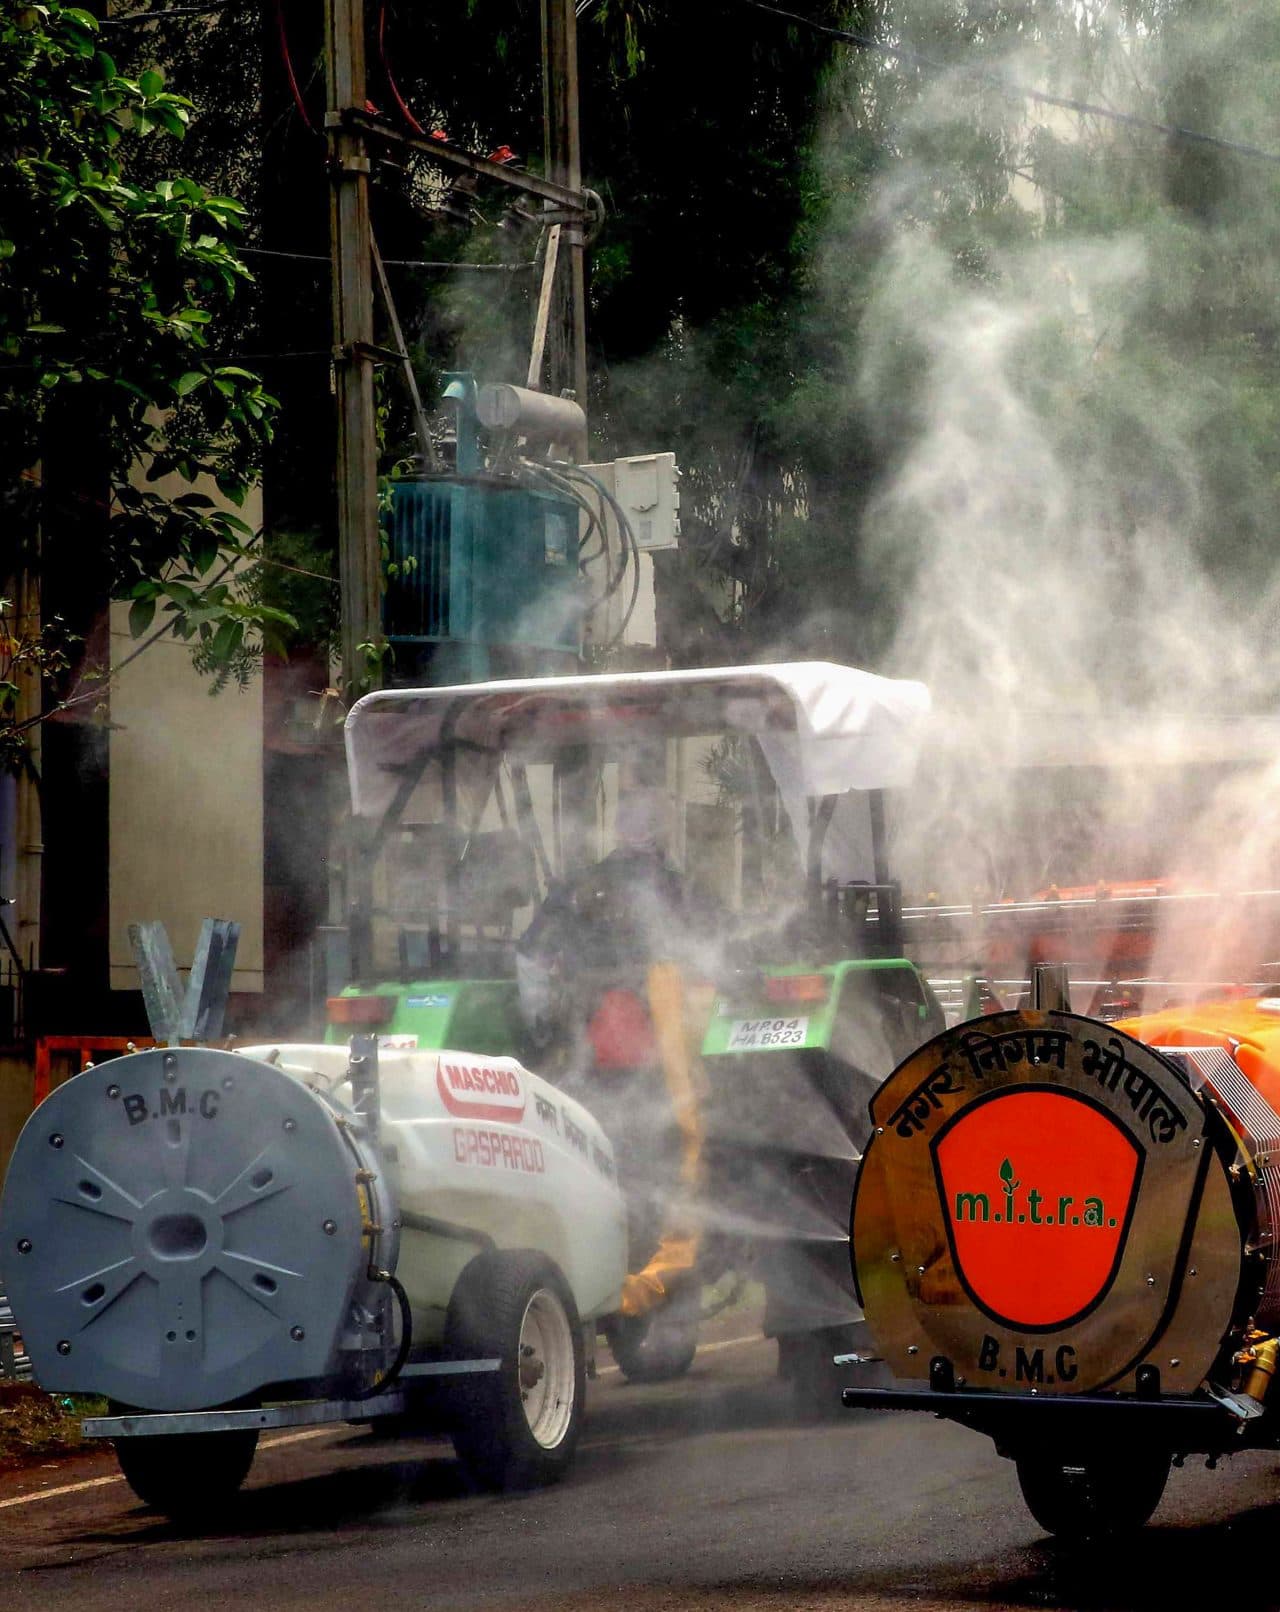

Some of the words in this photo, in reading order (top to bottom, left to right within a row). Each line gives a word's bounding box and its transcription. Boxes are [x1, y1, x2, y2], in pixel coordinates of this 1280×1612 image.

[445, 1064, 520, 1097] MASCHIO
[887, 1062, 966, 1138] नगर
[959, 1029, 1073, 1080] निगम
[1082, 1036, 1188, 1144] भोपाल
[452, 1127, 545, 1174] GASPARDO
